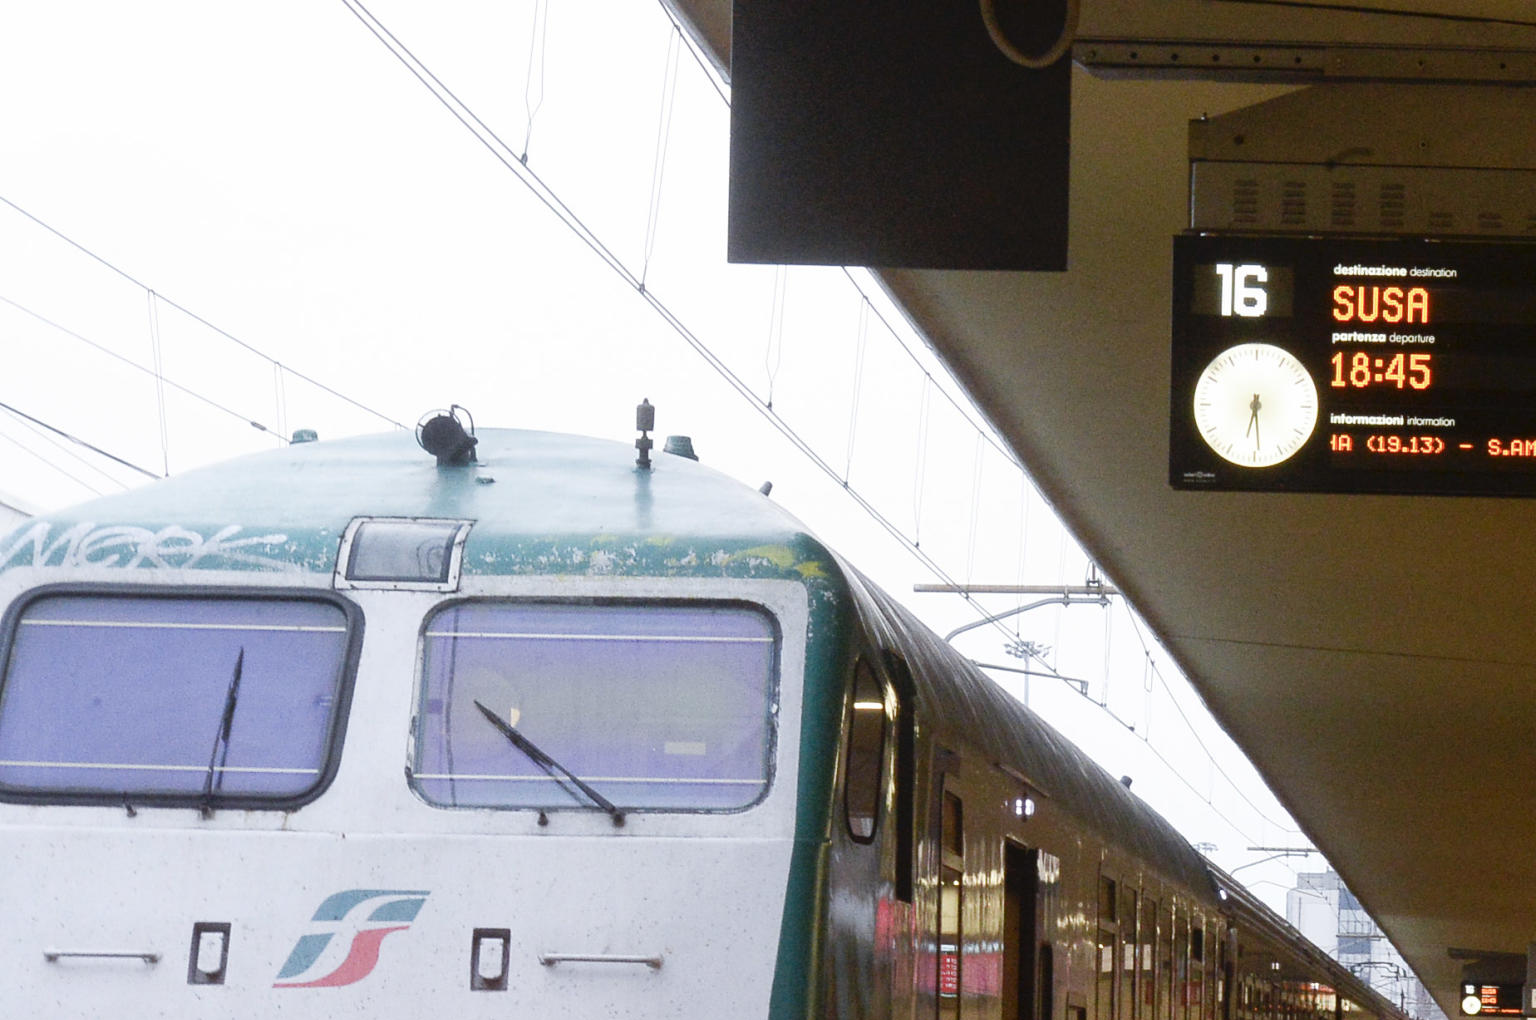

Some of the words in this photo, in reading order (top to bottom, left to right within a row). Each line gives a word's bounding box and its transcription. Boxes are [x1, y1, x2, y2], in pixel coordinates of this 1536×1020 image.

[1333, 264, 1407, 277] destinazione
[1410, 266, 1457, 278] destination
[1216, 264, 1268, 317] 16
[1333, 285, 1429, 324] SUSA
[1332, 331, 1387, 344] partenza
[1389, 332, 1436, 345] departure
[1331, 352, 1432, 389] 18:45
[1330, 413, 1405, 426] informazioni
[1407, 415, 1455, 427] information
[1367, 436, 1445, 453] (19.13)
